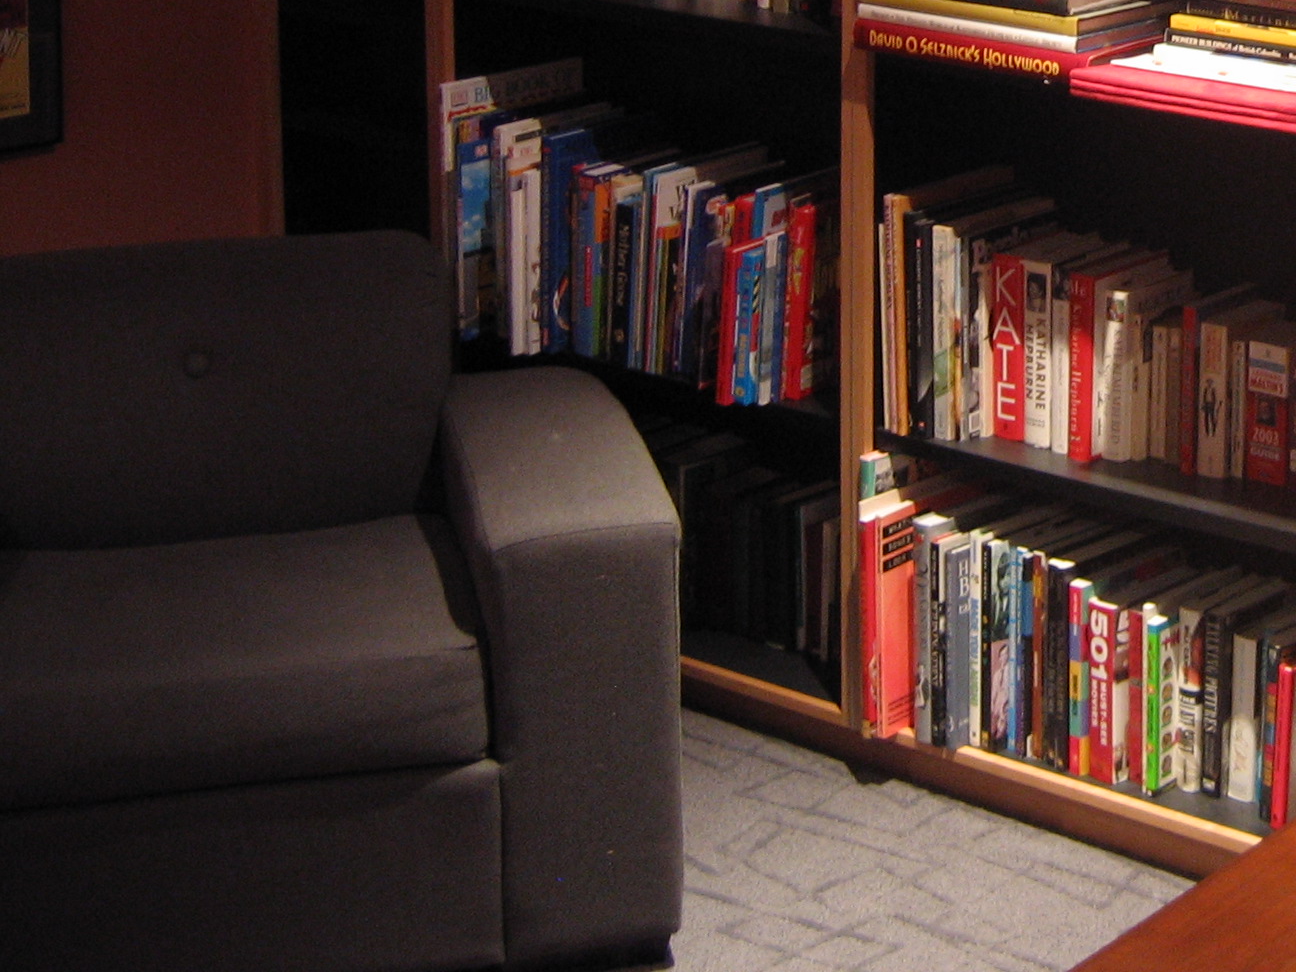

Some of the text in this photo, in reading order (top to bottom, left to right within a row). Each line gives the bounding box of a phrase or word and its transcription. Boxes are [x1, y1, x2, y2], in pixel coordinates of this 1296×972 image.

[869, 29, 1060, 76] DAVID SELZNICK'S HOLLYWOOD
[615, 271, 629, 307] Goose
[992, 266, 1022, 421] KATE
[1025, 323, 1034, 399] HEPBURN
[1035, 318, 1047, 410] KATHARINE
[1068, 305, 1083, 432] Katharine Hepburn
[1090, 608, 1110, 681] 501
[1091, 678, 1099, 727] MOVIES
[1100, 681, 1108, 746] MUST-SEE
